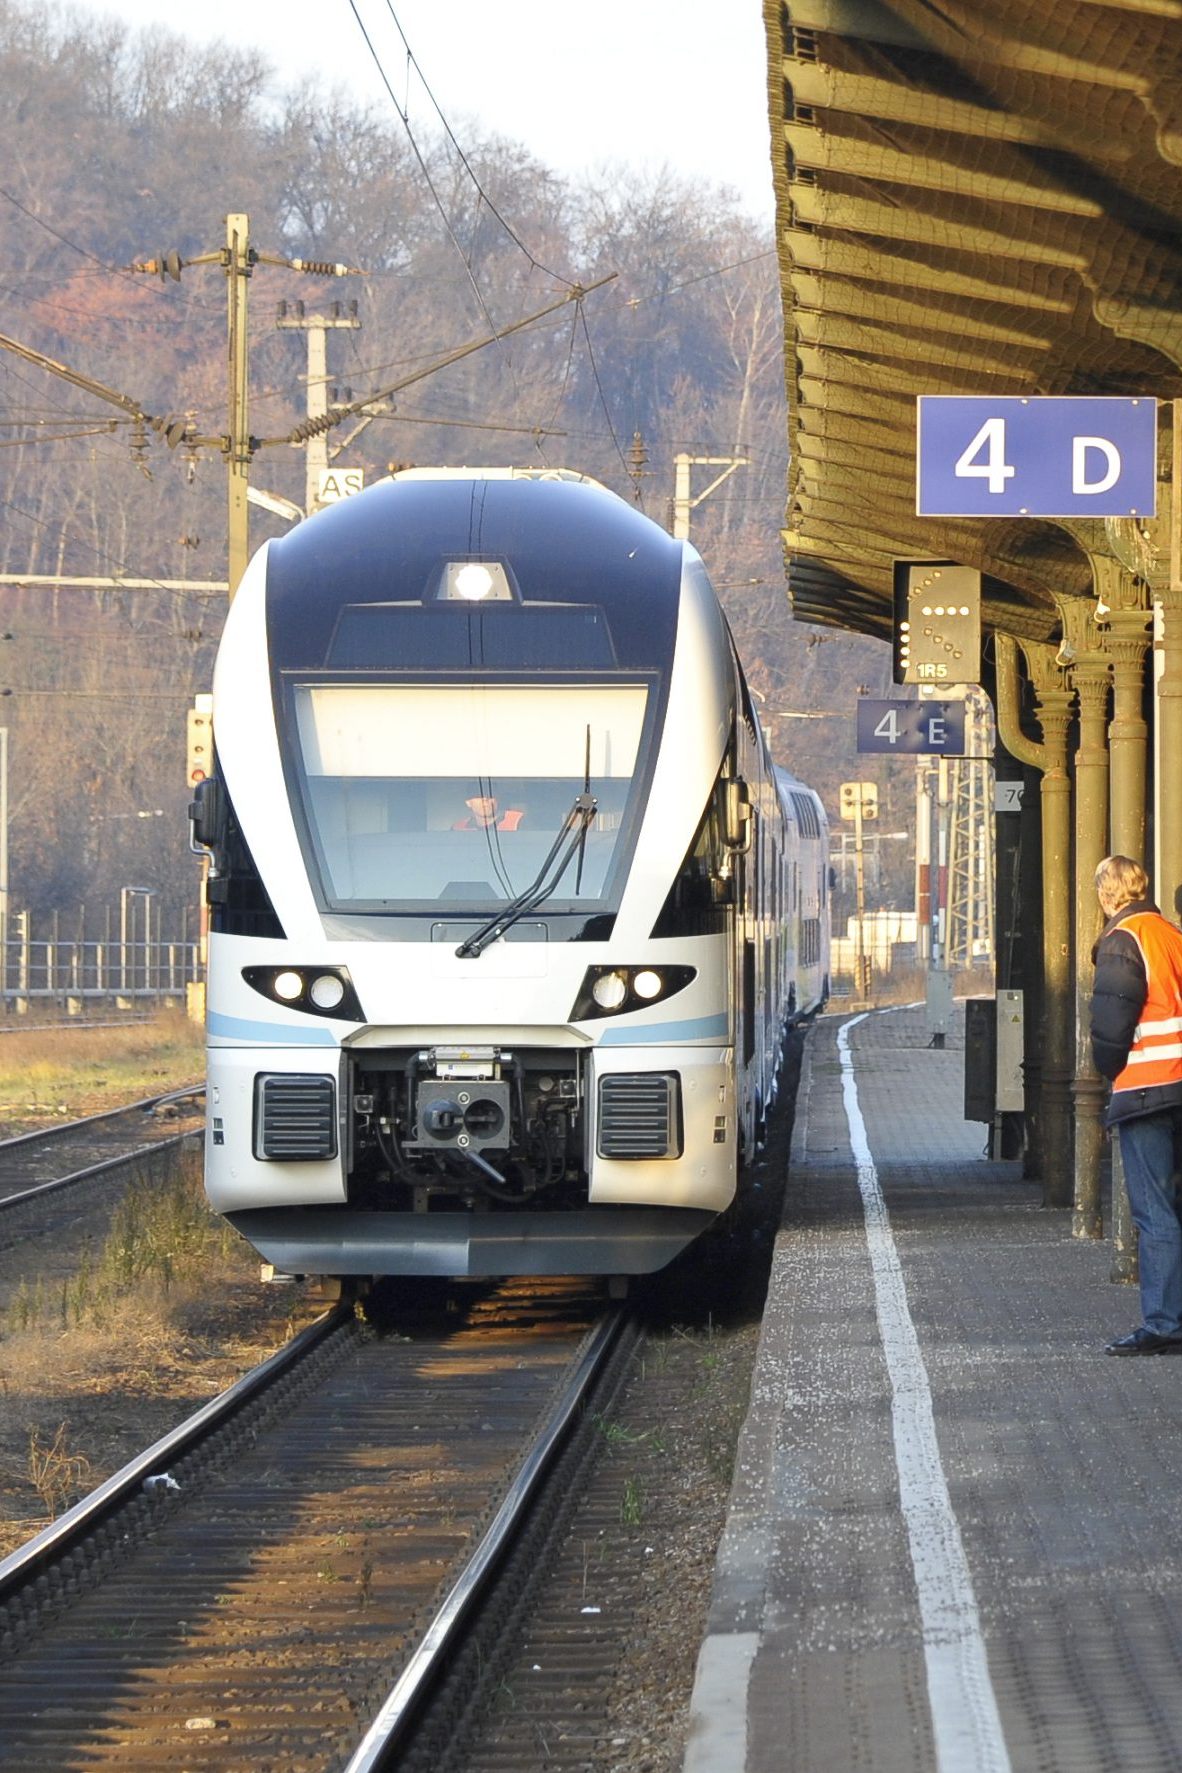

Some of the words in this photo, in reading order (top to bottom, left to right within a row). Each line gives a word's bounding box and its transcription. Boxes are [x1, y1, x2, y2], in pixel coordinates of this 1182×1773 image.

[955, 418, 1015, 494] 4
[1072, 436, 1121, 495] D
[322, 475, 361, 497] AS
[917, 664, 948, 678] 1R5
[874, 709, 902, 744] 4
[928, 718, 945, 744] E
